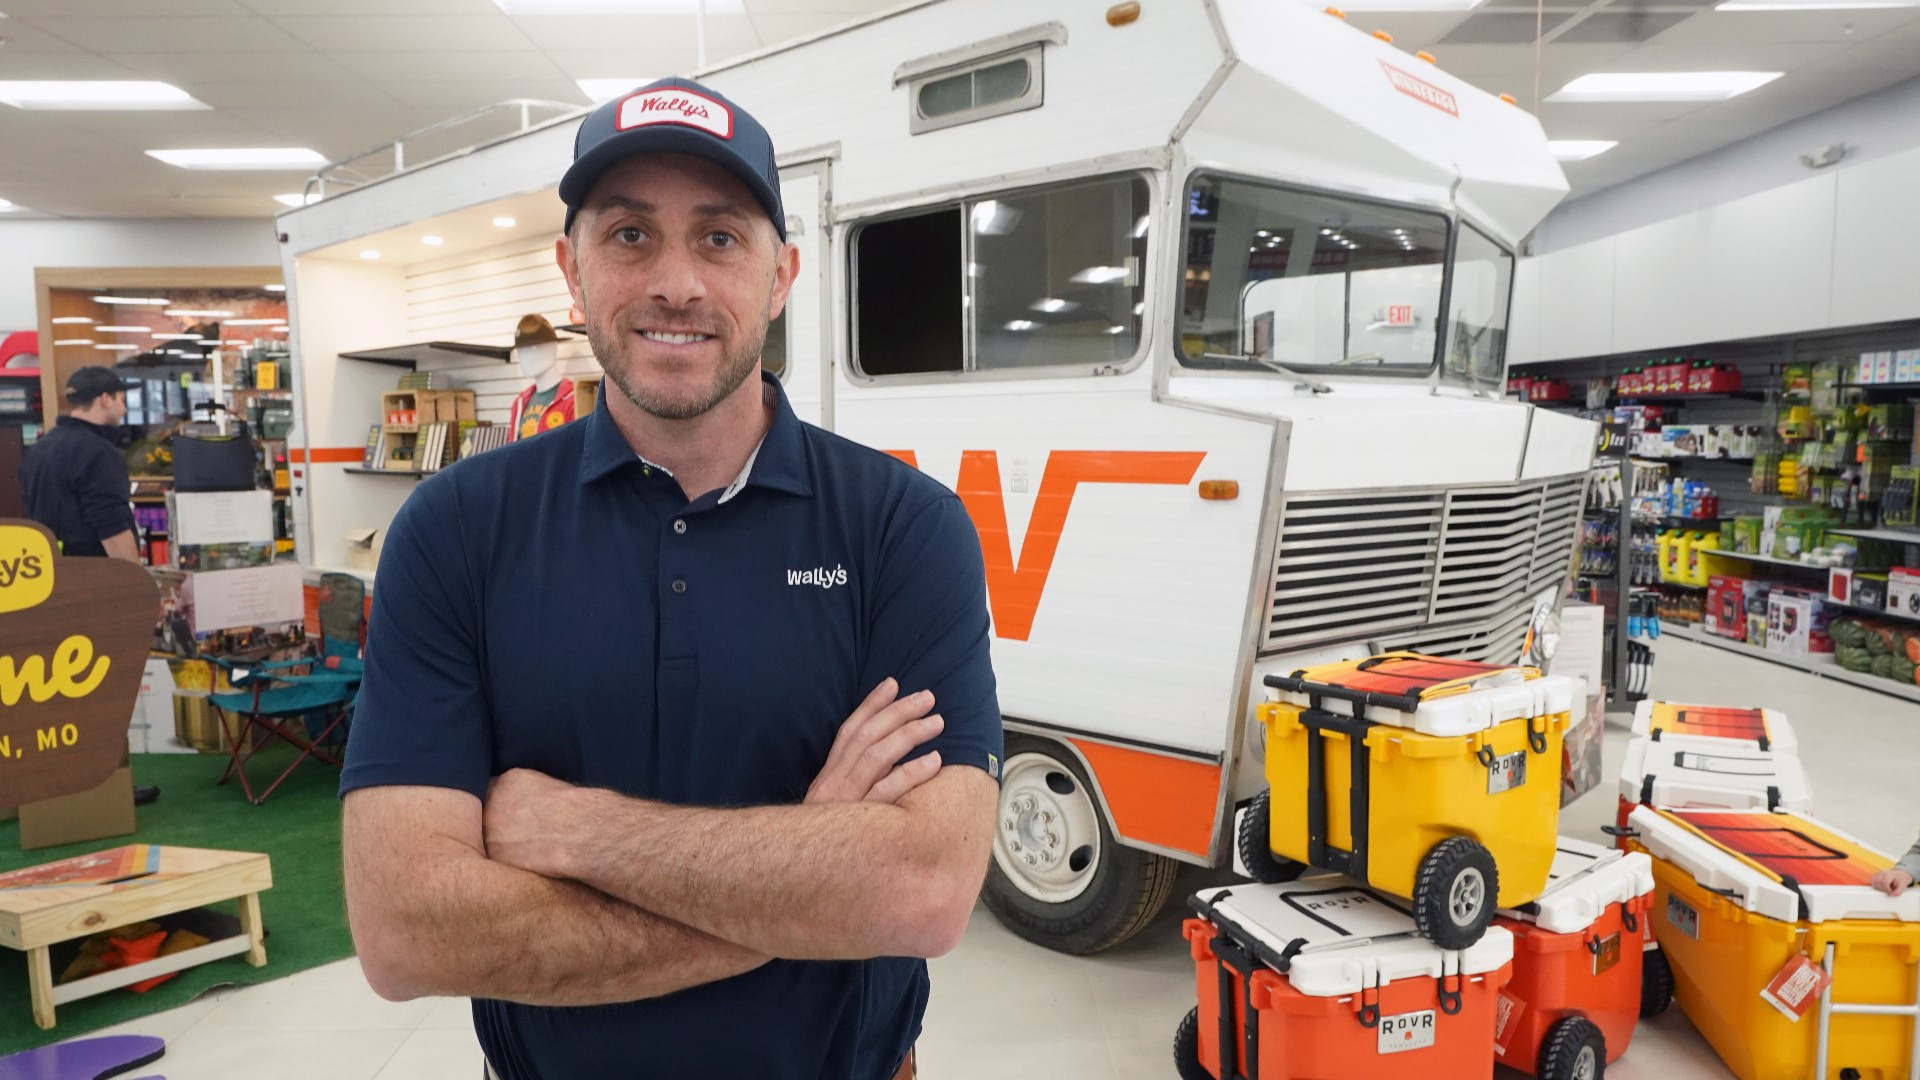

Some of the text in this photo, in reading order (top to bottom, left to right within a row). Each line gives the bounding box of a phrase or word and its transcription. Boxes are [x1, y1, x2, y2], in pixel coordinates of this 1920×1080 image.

[641, 97, 710, 119] Wally's
[1389, 305, 1411, 323] EXIT
[0, 547, 42, 588] y's
[37, 723, 78, 751] MO
[1491, 755, 1526, 776] ROVR
[1306, 896, 1372, 910] ROVR
[1382, 1013, 1433, 1035] ROVR
